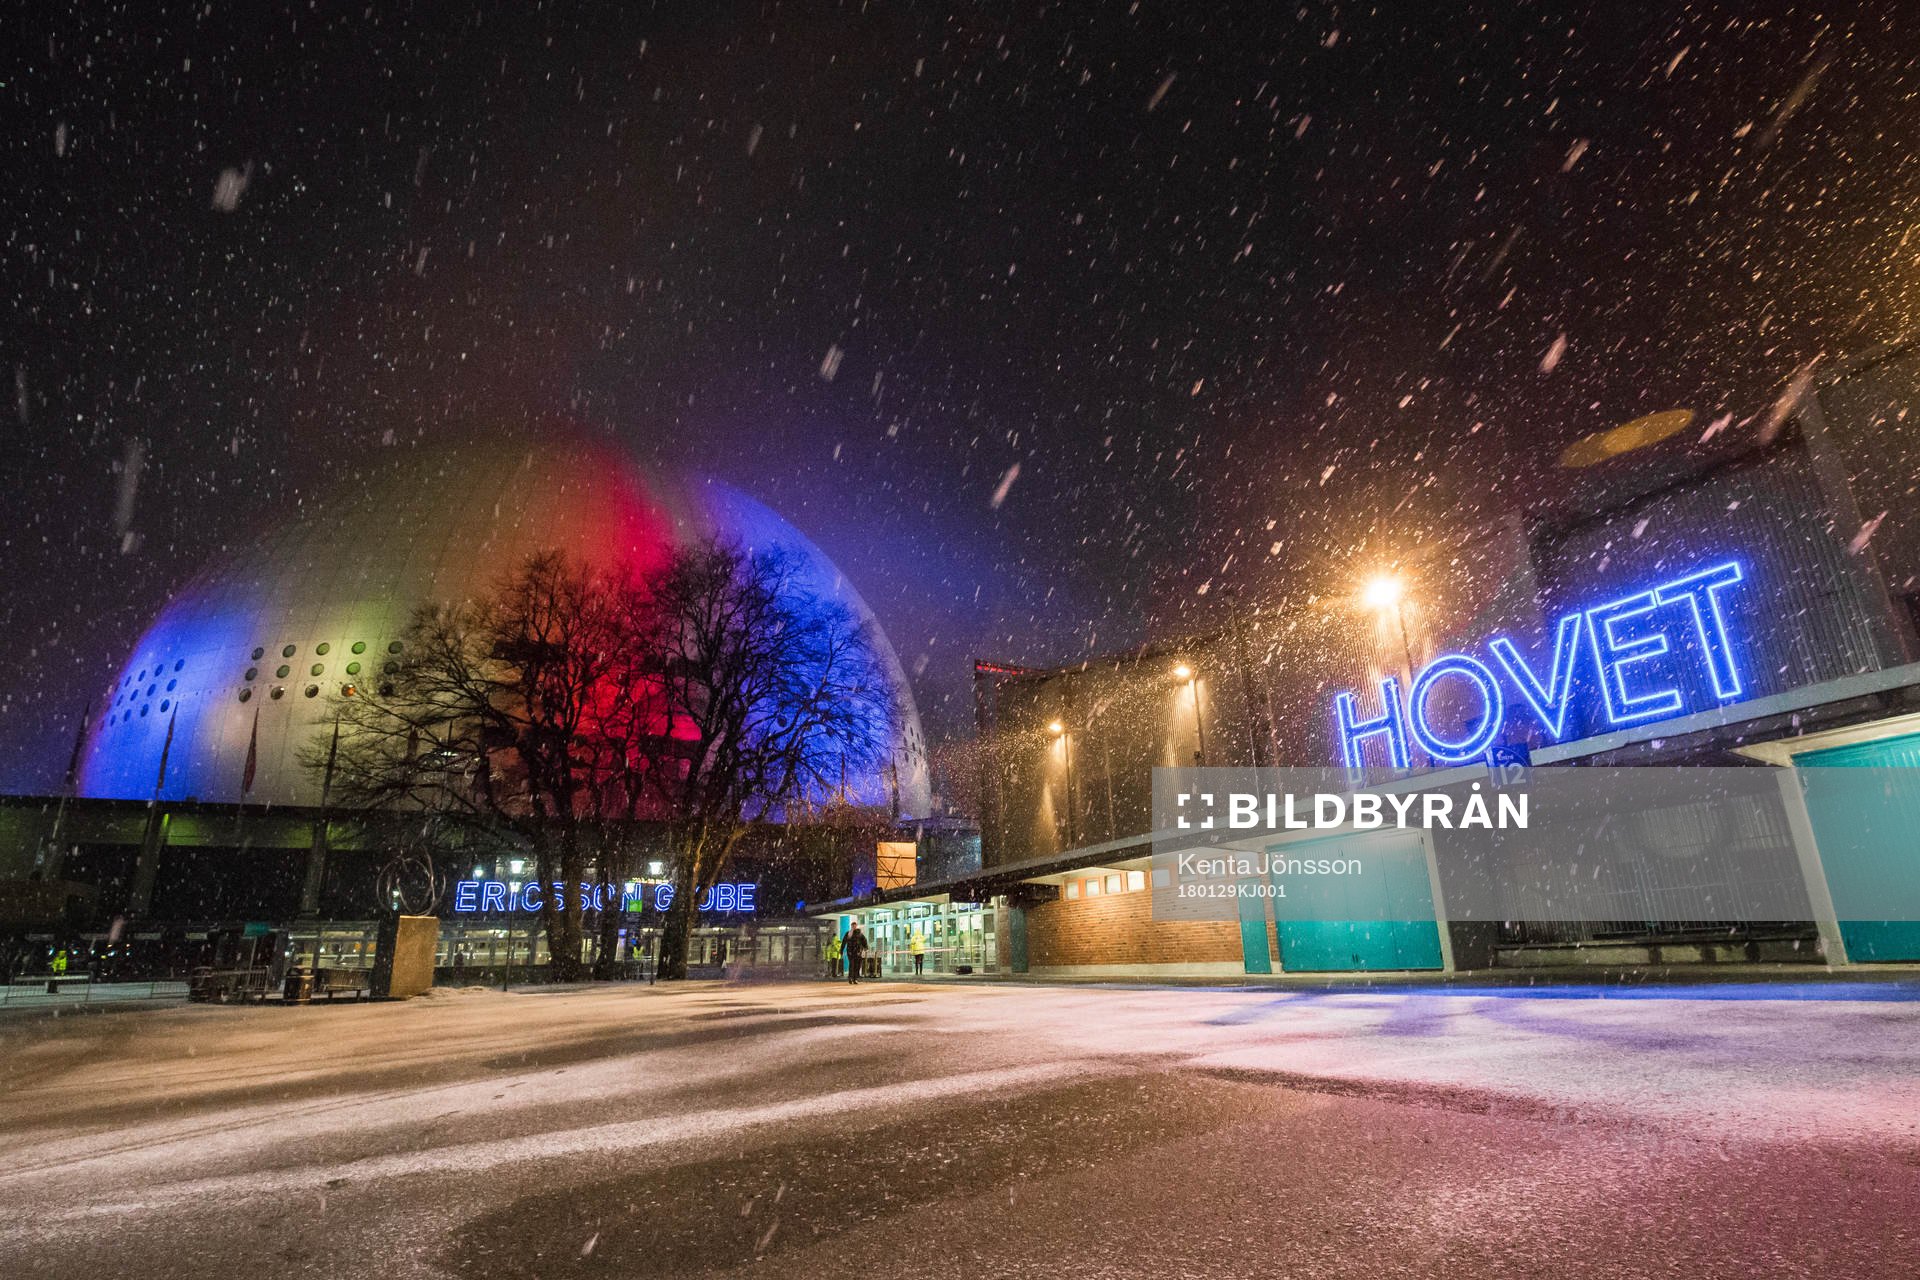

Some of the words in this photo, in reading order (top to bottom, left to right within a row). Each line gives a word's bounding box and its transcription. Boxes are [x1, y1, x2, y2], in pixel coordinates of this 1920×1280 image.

[1336, 562, 1742, 783] HOVET
[1500, 762, 1526, 785] 12
[654, 883, 756, 911] GOBE
